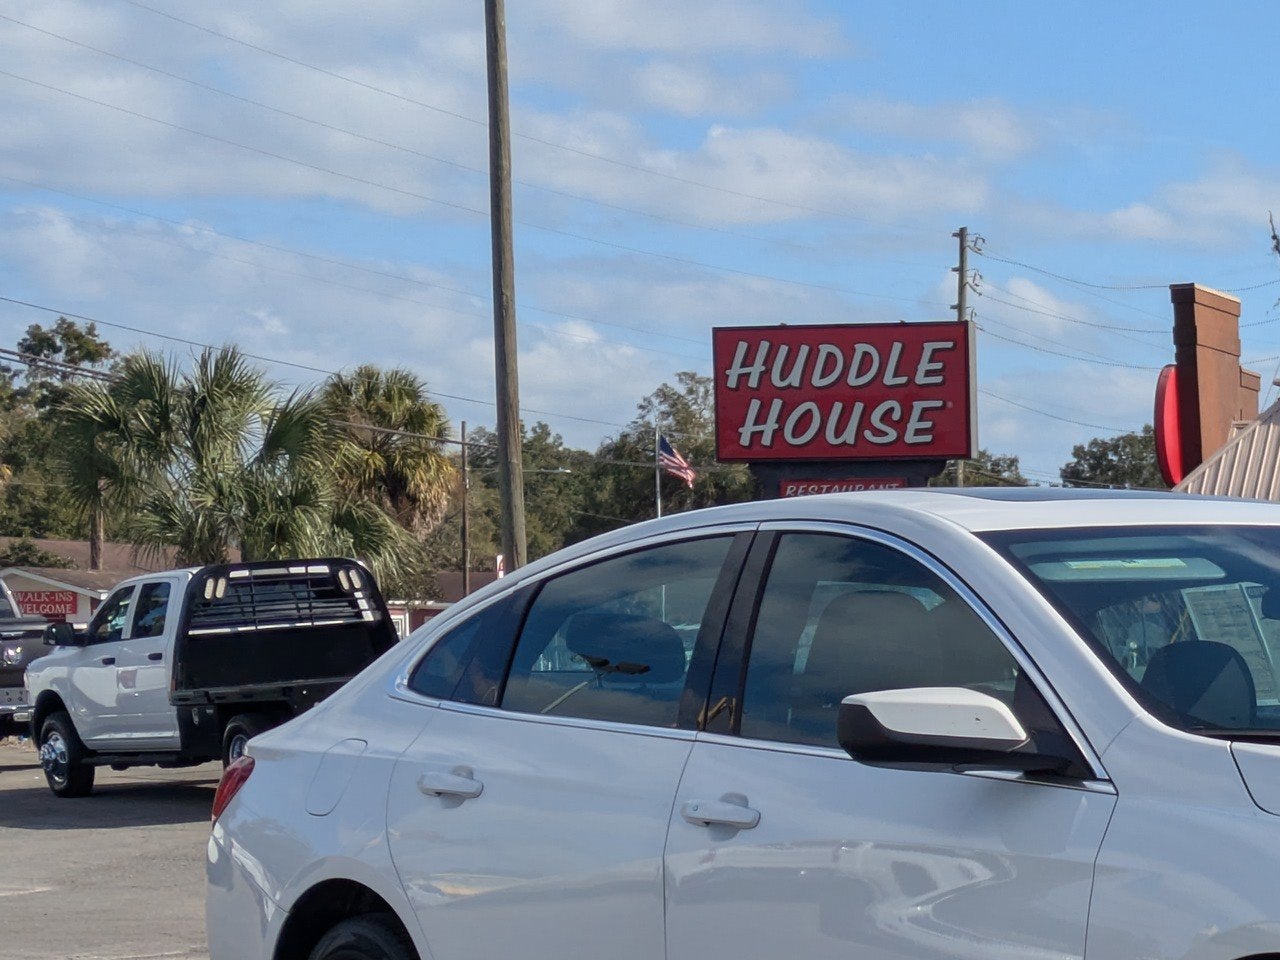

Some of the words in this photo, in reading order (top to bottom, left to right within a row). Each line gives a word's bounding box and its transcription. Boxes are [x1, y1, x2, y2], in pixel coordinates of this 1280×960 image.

[725, 340, 955, 389] HUDDLE
[737, 398, 944, 447] HOUSE
[14, 591, 73, 602] WALK-INS
